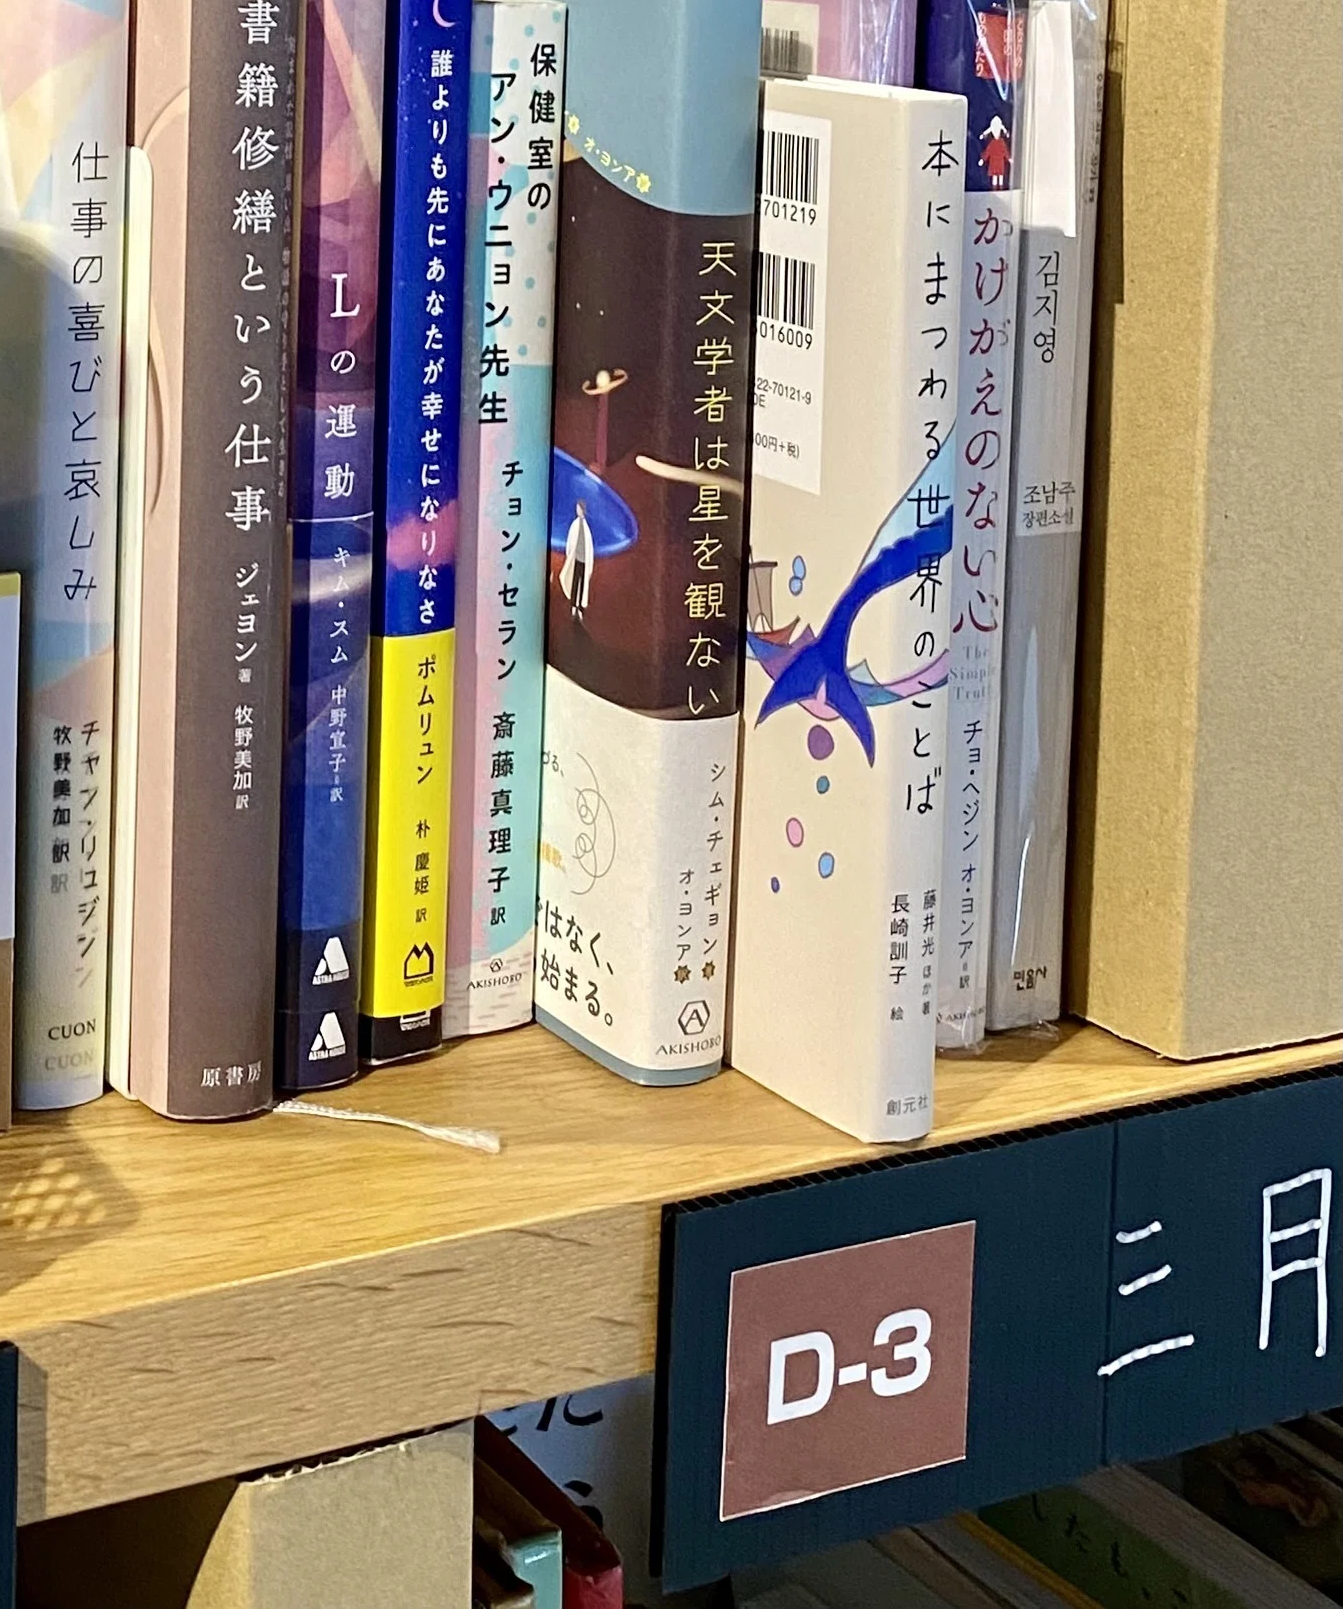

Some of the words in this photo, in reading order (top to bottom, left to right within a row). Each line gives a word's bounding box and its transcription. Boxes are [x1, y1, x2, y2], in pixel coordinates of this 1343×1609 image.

[526, 42, 558, 211] 保健室の
[477, 71, 518, 425] アン・ウニョン先生
[1032, 249, 1061, 365] 김지영
[63, 140, 111, 602] 仕事の喜びと哀しみ
[323, 272, 362, 501] Lの運動
[418, 49, 454, 625] 誰よりも先にあなたが幸せになりなさ
[683, 241, 739, 717] 天文学者は星を観ない
[905, 129, 960, 815] 本にまつわる世界のことば
[951, 206, 1011, 636] かけがえのない心
[1023, 479, 1076, 507] 조남주
[329, 546, 351, 664] キム・スム
[495, 459, 525, 682] チョン・セラン
[416, 653, 438, 785] ポムリュン
[961, 719, 982, 852] チョ・ヘジン
[676, 868, 696, 962] オ・ヨンア
[703, 762, 727, 955] シム・チェギョン
[467, 972, 524, 991] AKISHOBO
[537, 896, 614, 976] はなく、
[540, 947, 614, 1028] 始まる。
[889, 893, 910, 986] 長崎訓子
[1013, 965, 1048, 992] 민음사
[48, 1018, 97, 1042] CUON
[654, 1035, 722, 1057] AKISHOBO
[889, 1006, 905, 1023] 絵
[200, 1060, 264, 1089] 原書房
[885, 1094, 930, 1117] 創元社
[766, 1307, 933, 1425] D-3
